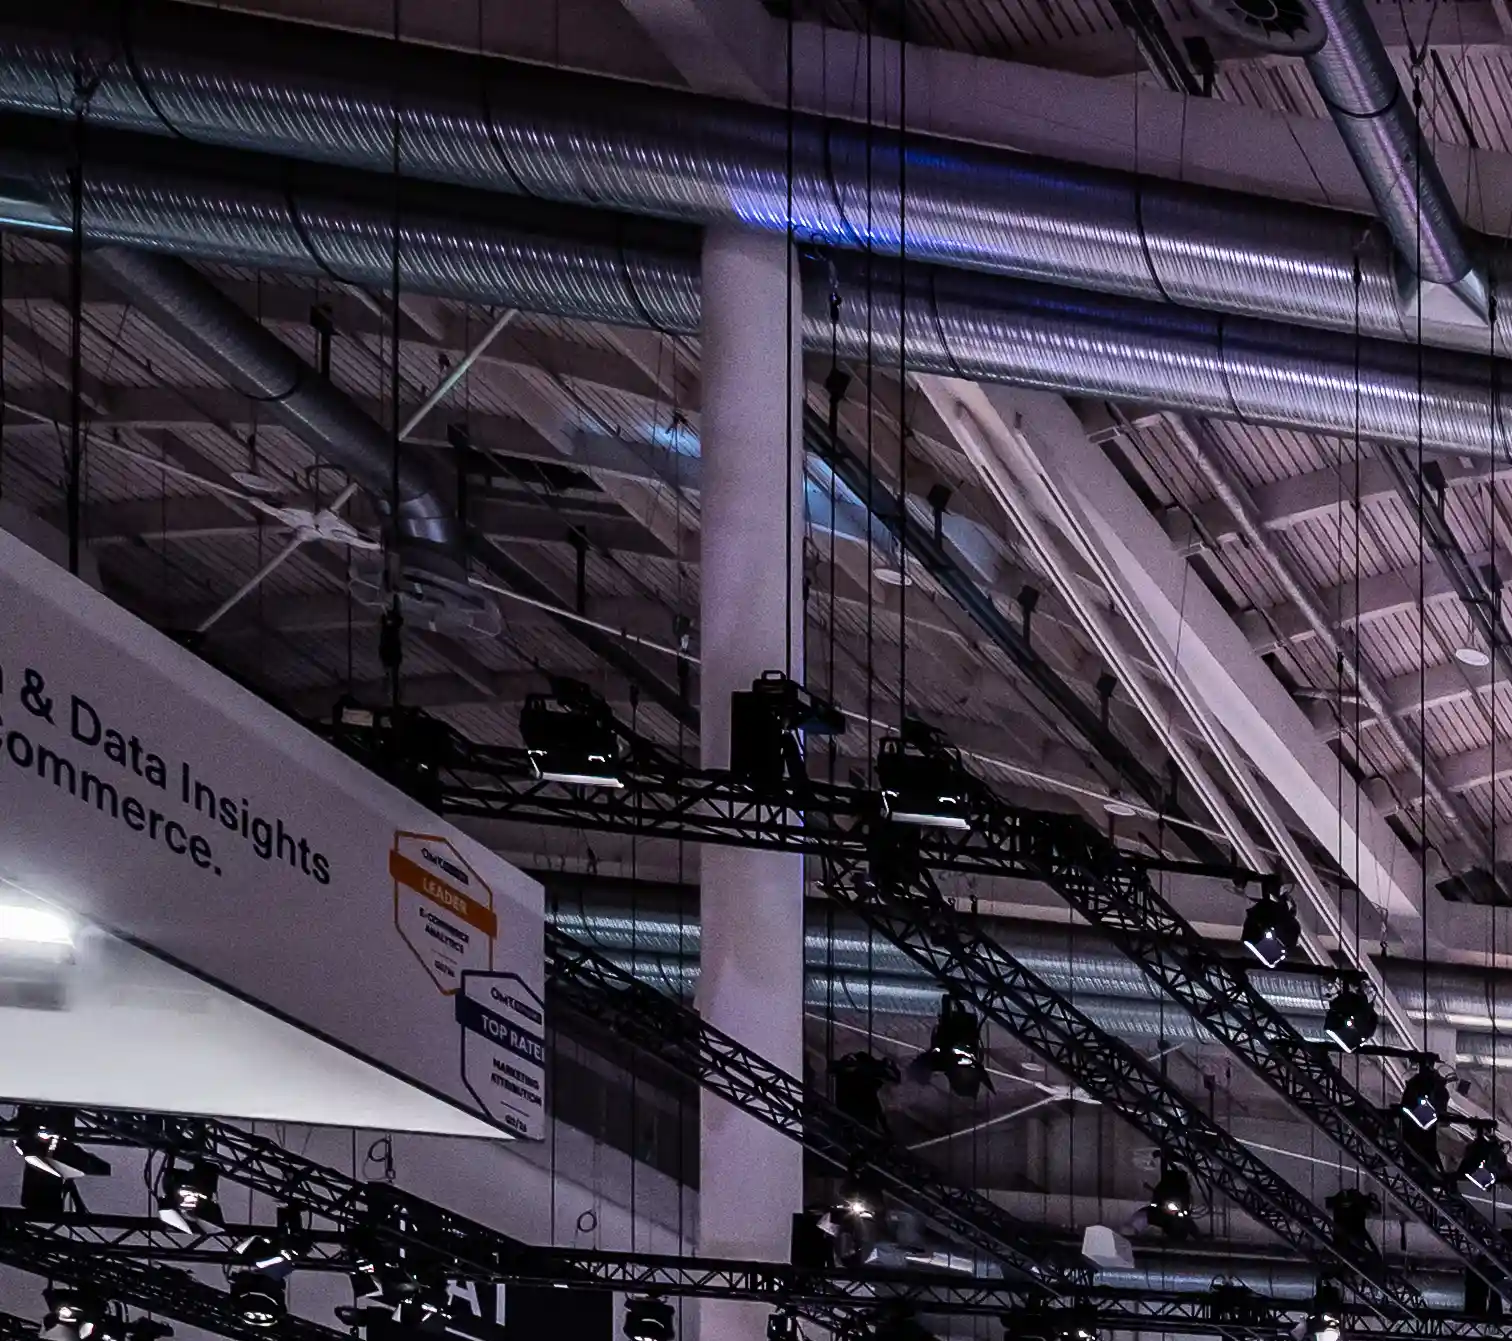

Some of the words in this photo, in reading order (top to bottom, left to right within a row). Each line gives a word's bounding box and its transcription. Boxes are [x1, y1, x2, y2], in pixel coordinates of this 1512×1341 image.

[0, 730, 222, 876] ommerce.
[20, 668, 56, 725] &
[70, 694, 167, 790] Data
[182, 762, 330, 885] Insights
[423, 877, 468, 915] LEADER
[481, 1014, 507, 1040] TOP
